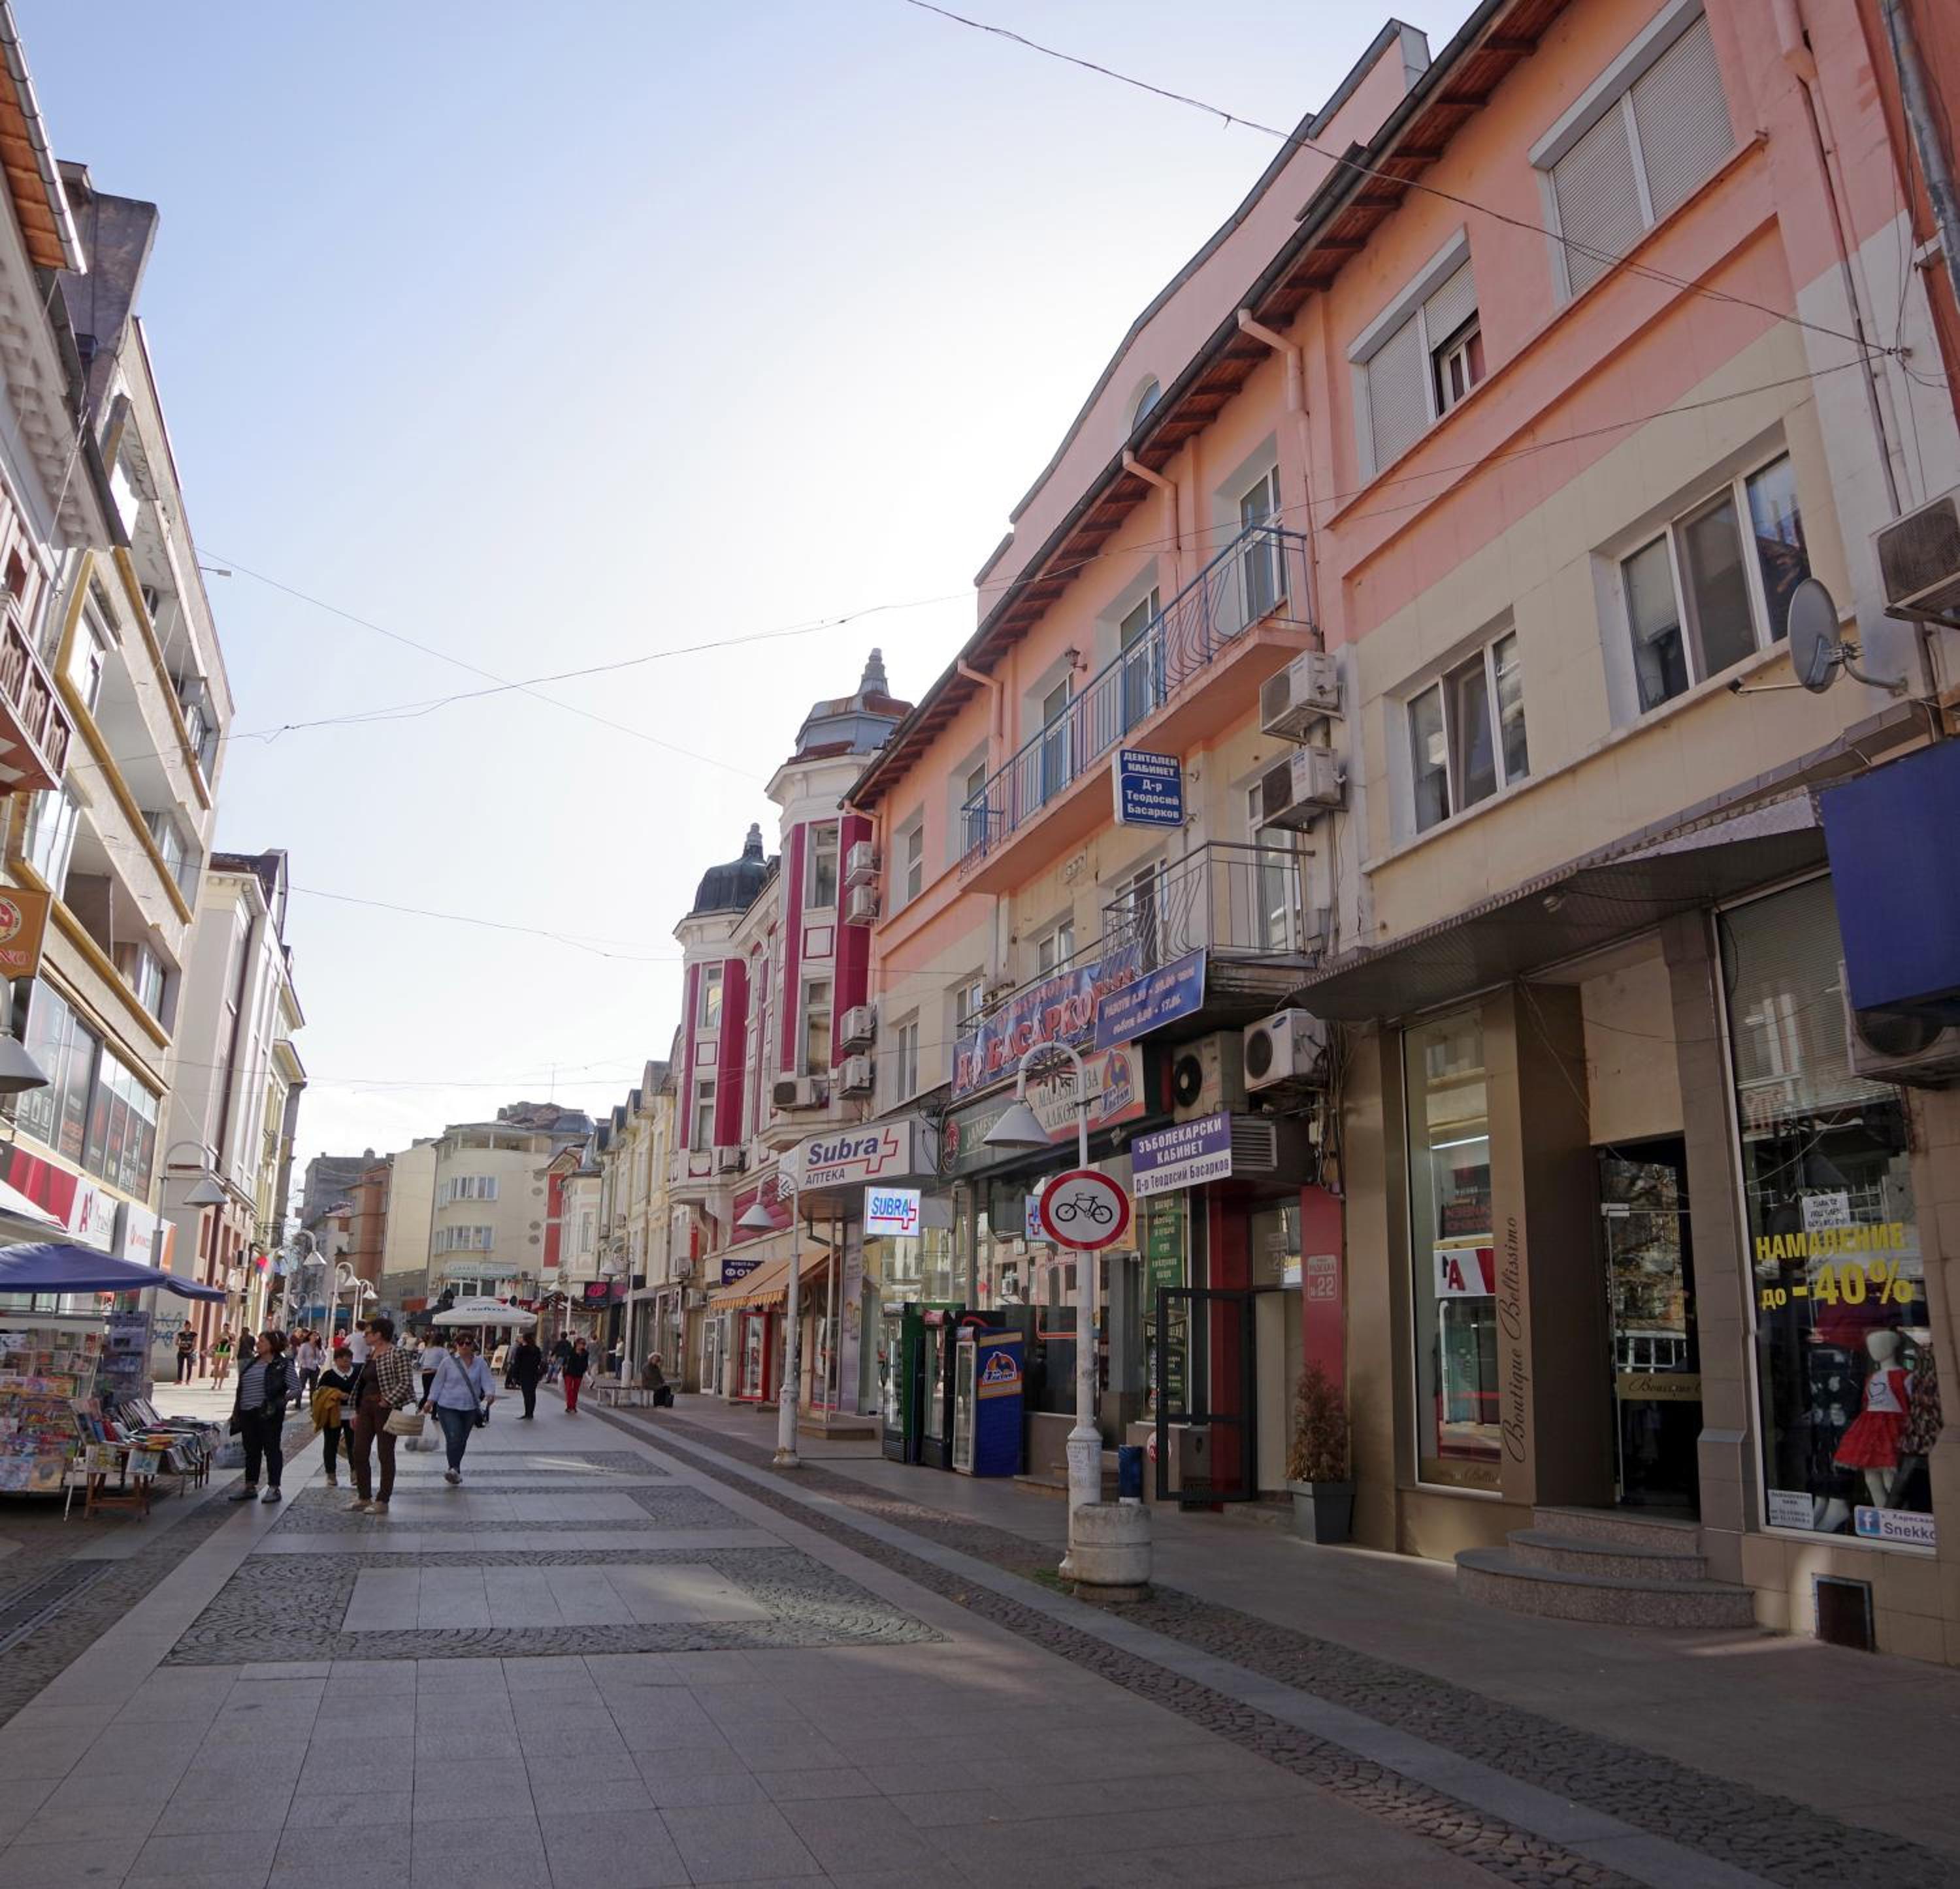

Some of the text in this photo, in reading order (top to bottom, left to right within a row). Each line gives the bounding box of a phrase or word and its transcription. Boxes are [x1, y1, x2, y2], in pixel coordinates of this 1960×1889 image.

[1123, 752, 1177, 766] ДЕНТАЛЕН
[1128, 763, 1175, 776] КАБИНЕТ
[1143, 779, 1162, 792] Д-р
[1126, 790, 1179, 805] Теодосий
[1127, 803, 1179, 818] Басарков
[1139, 1117, 1222, 1155] ЗЪБОЛЕКАРСКИ
[808, 1137, 879, 1165] Subra
[1156, 1140, 1203, 1165] КАБИНЕТ
[805, 1168, 845, 1186] АПТЕКА
[1136, 1178, 1149, 1193] Д-р
[1190, 1158, 1229, 1179] Басарков
[871, 1197, 909, 1217] SUBRA
[1756, 1222, 1905, 1261] НАМАЛЕНИЕ
[725, 1268, 753, 1277] ФОТ
[1317, 1276, 1335, 1297] 22
[1762, 1288, 1787, 1311] до
[1499, 1216, 1531, 1464] Boutique Bellissimo
